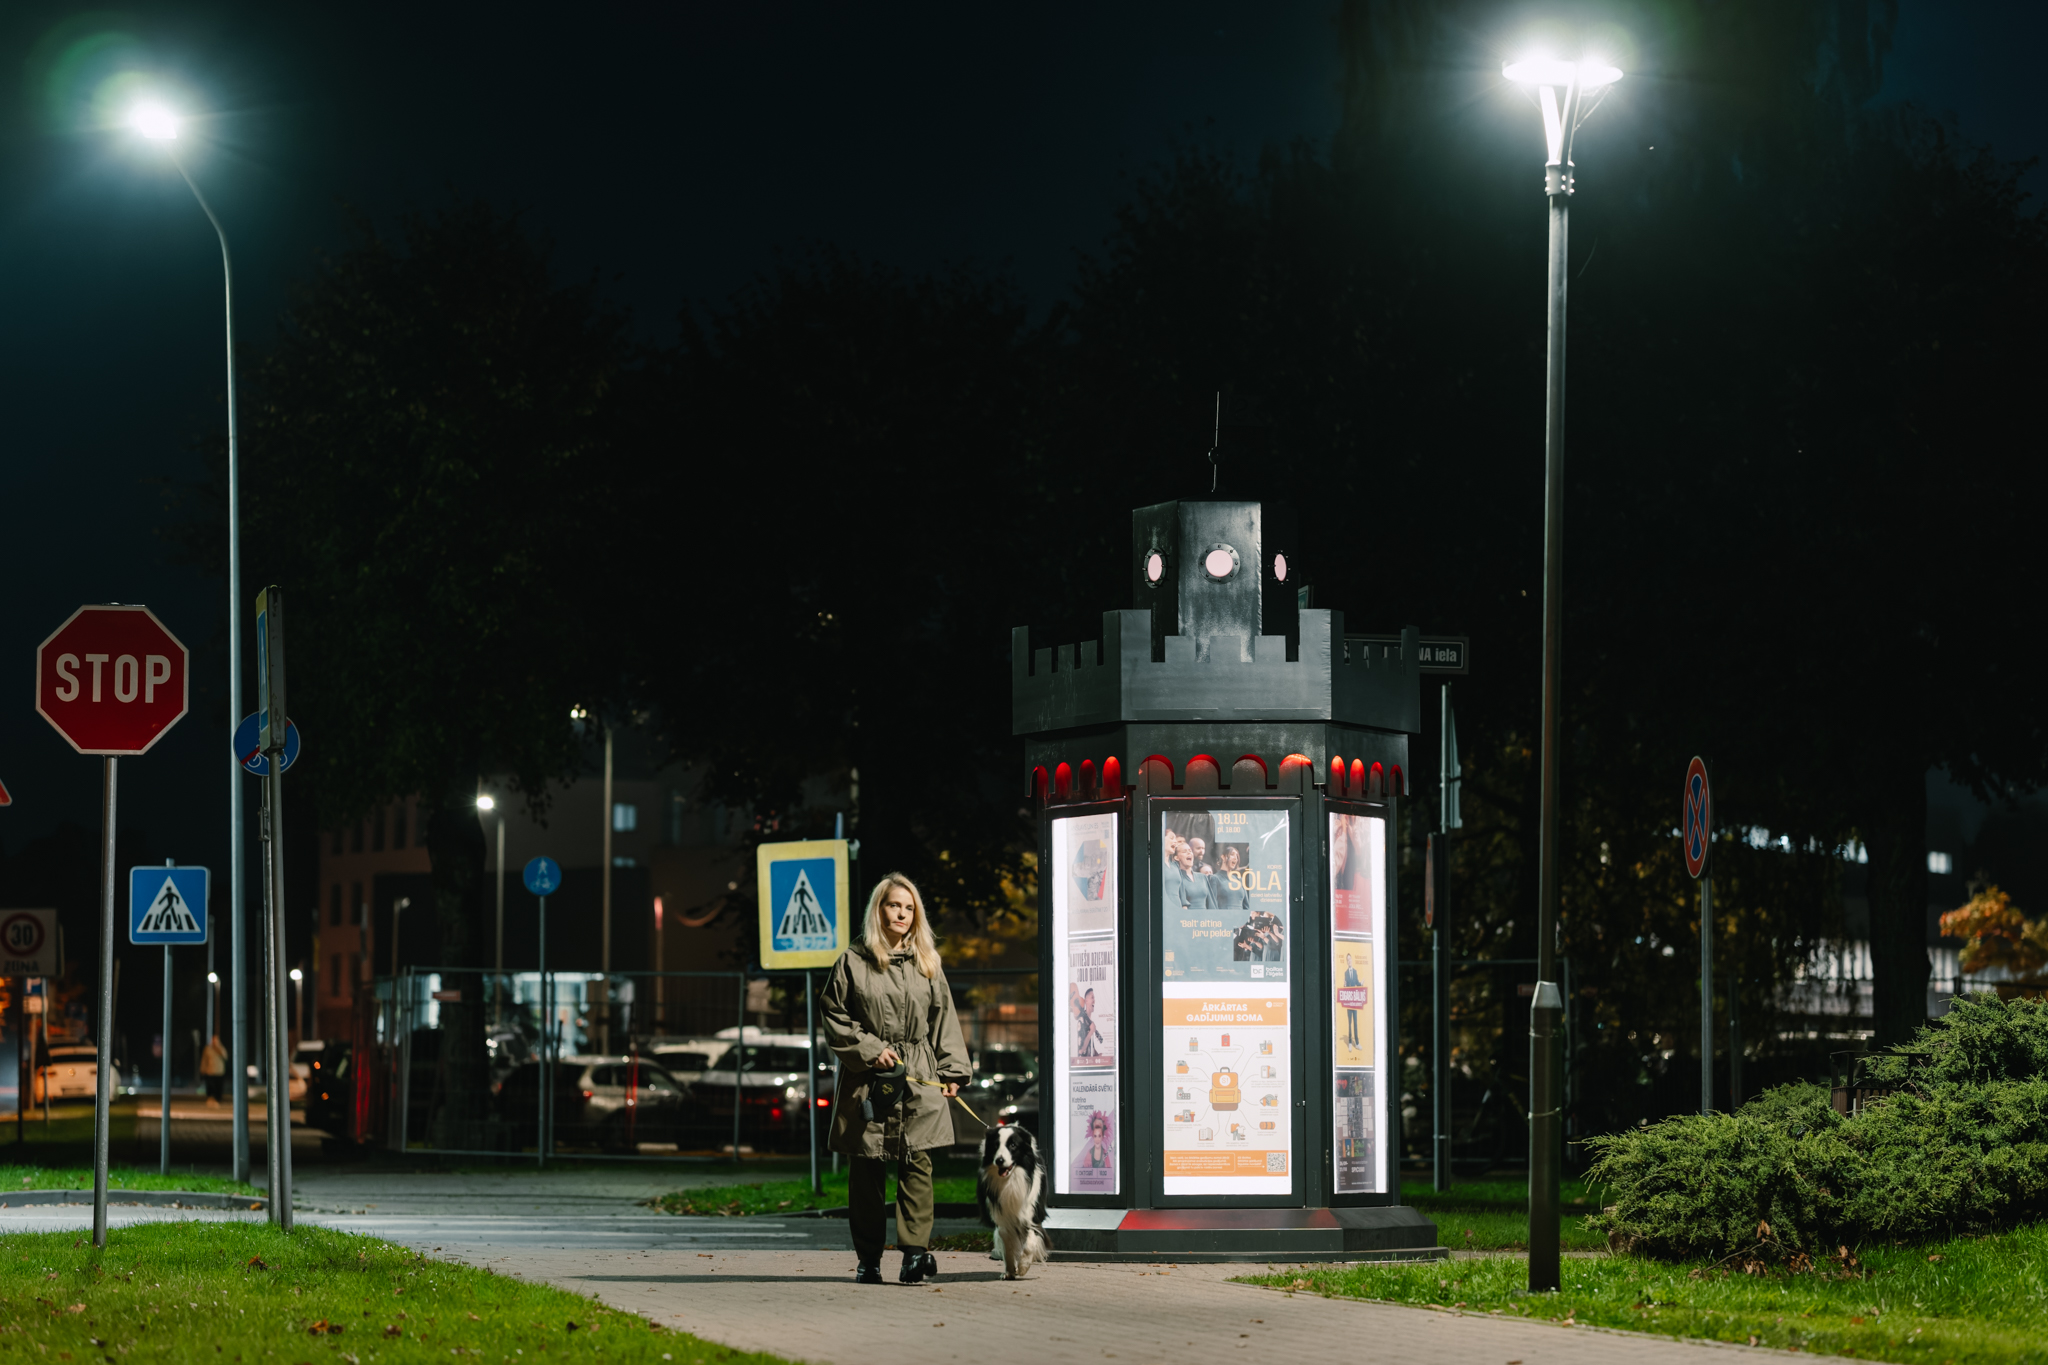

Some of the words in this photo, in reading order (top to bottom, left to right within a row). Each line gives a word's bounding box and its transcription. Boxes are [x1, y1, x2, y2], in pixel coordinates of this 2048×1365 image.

[1435, 647, 1457, 662] iela
[55, 652, 171, 704] STOP
[1217, 812, 1249, 825] 18.10.
[1228, 868, 1282, 891] SŌLA
[11, 924, 34, 946] 30
[1201, 1002, 1248, 1012] ĀRKĀRTAS
[1186, 1012, 1234, 1022] GADĪJUMU
[1236, 1013, 1264, 1022] SOMA
